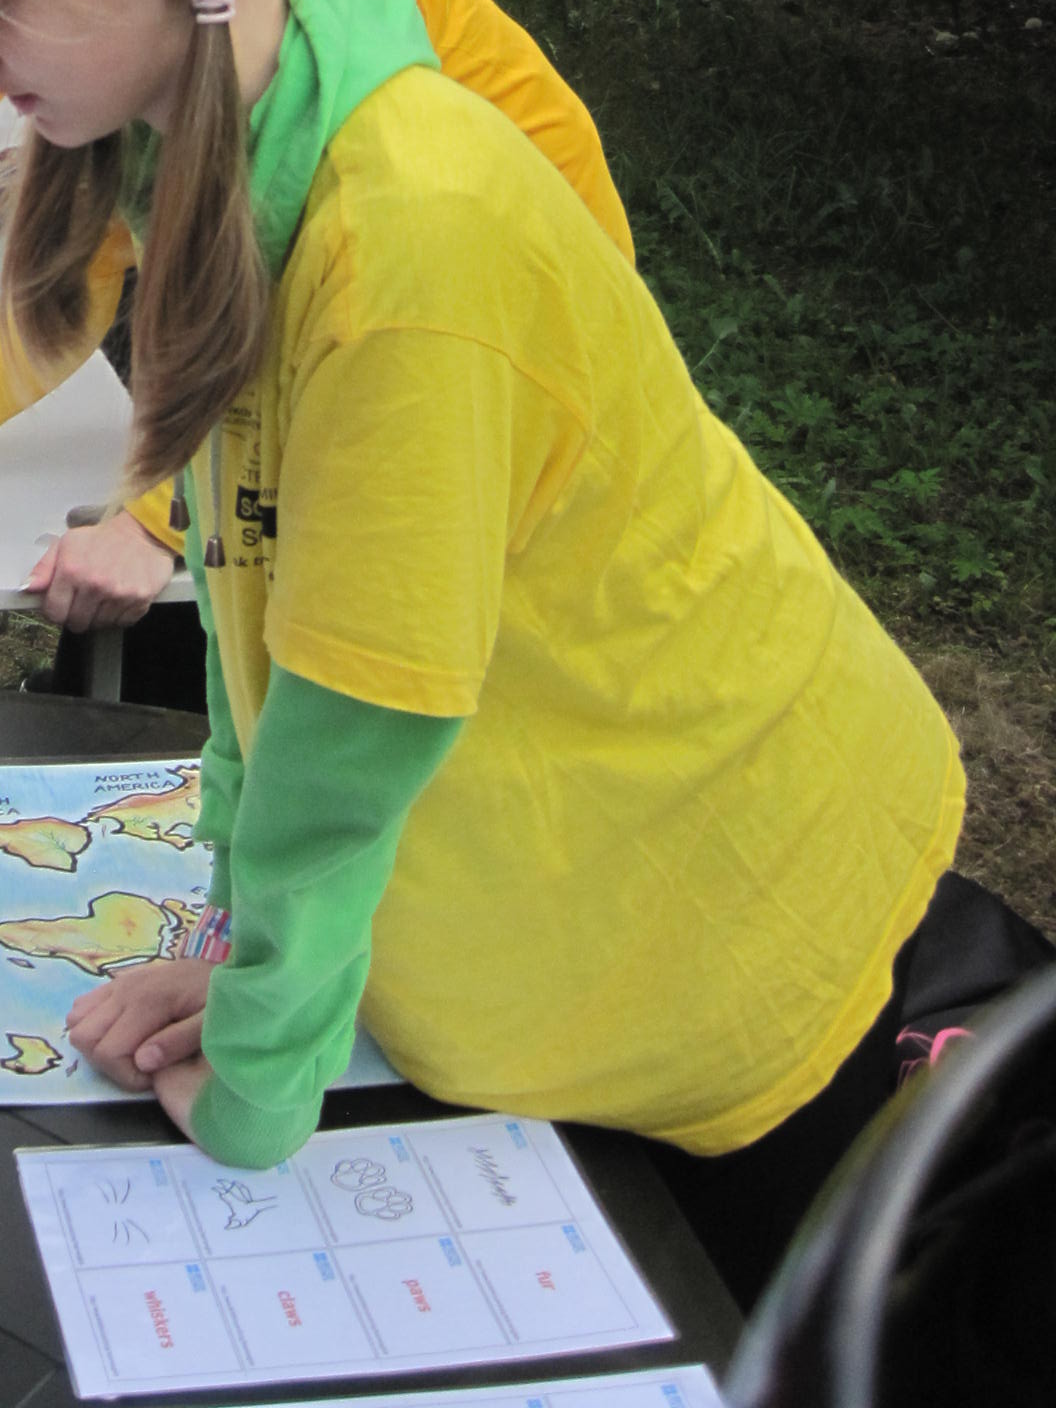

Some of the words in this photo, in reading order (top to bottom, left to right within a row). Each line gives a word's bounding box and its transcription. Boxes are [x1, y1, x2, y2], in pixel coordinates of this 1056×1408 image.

[94, 771, 161, 783] NORTH
[94, 780, 176, 792] AMERICA
[535, 1270, 556, 1291] fur
[277, 1291, 302, 1327] claws
[401, 1279, 431, 1313] paws
[144, 1291, 174, 1349] whiskers
